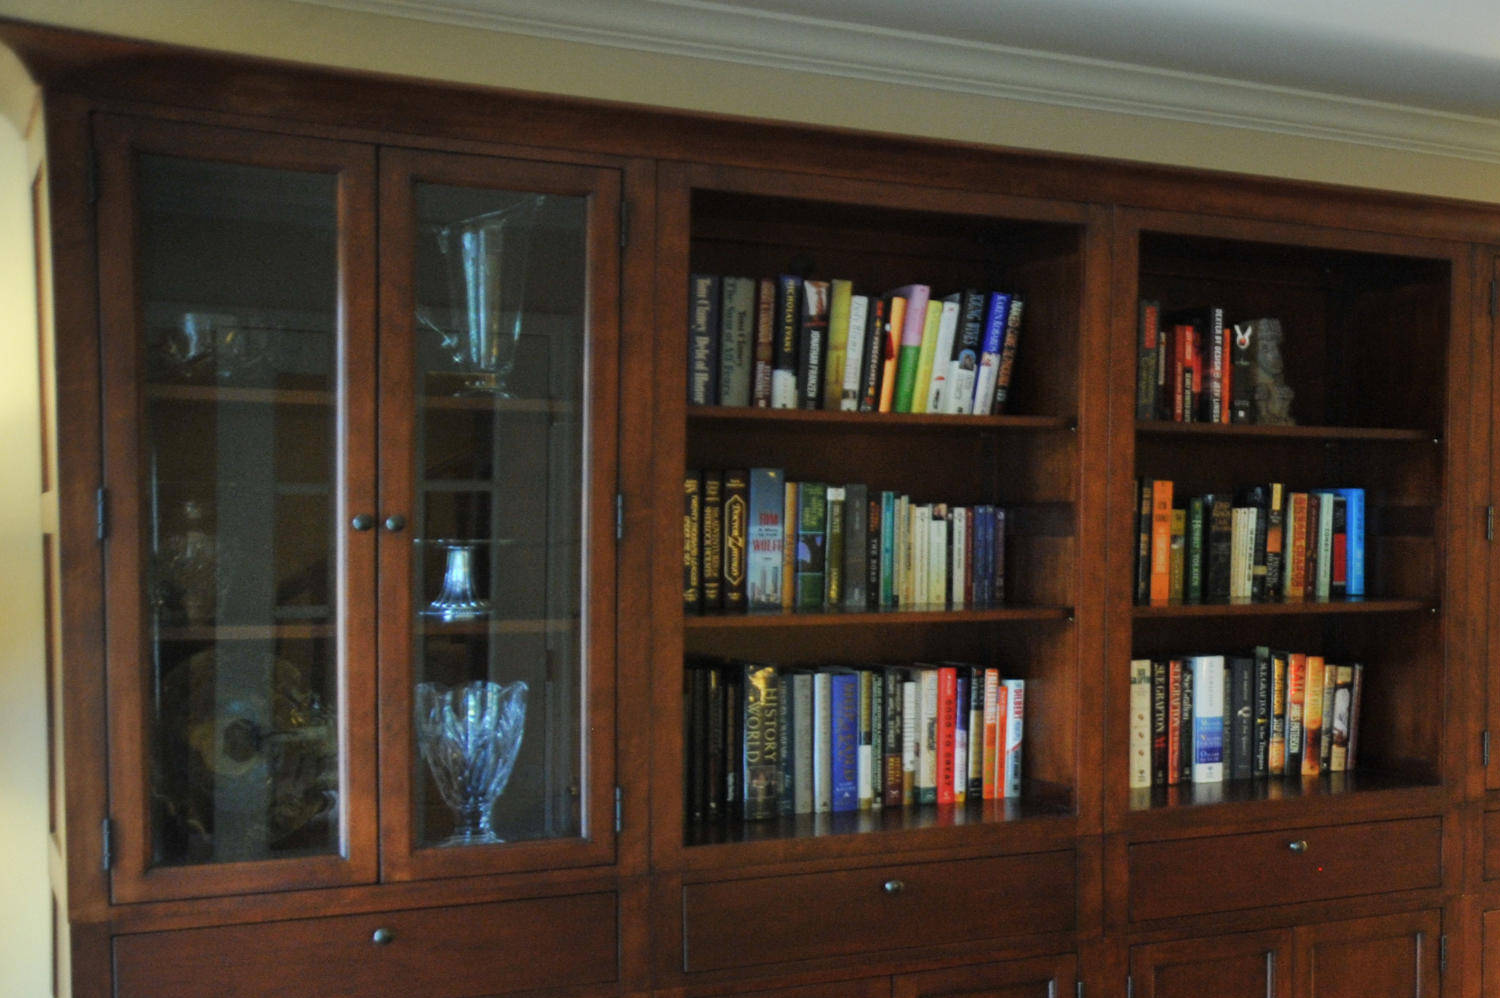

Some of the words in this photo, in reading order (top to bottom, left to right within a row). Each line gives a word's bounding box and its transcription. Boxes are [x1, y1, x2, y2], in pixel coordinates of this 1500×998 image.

[697, 278, 711, 298] Tom
[786, 279, 795, 323] NICHOLAS
[692, 300, 710, 331] Clancy
[994, 295, 1008, 319] KAREN
[695, 336, 710, 359] Debt
[784, 326, 792, 352] EVANS
[809, 330, 820, 364] JONATHAN
[1215, 336, 1222, 344] BY
[695, 361, 708, 370] of
[695, 373, 708, 404] Honor
[808, 366, 819, 398] FRANZEN
[1155, 663, 1165, 684] SUE
[1294, 664, 1304, 694] SAIL
[1014, 689, 1023, 720] DILBERT
[1155, 685, 1166, 732] GRAFTON
[1172, 683, 1180, 727] GRAFTON
[747, 702, 760, 763] WORLD
[764, 688, 777, 761] HISTORY
[945, 734, 952, 746] TO
